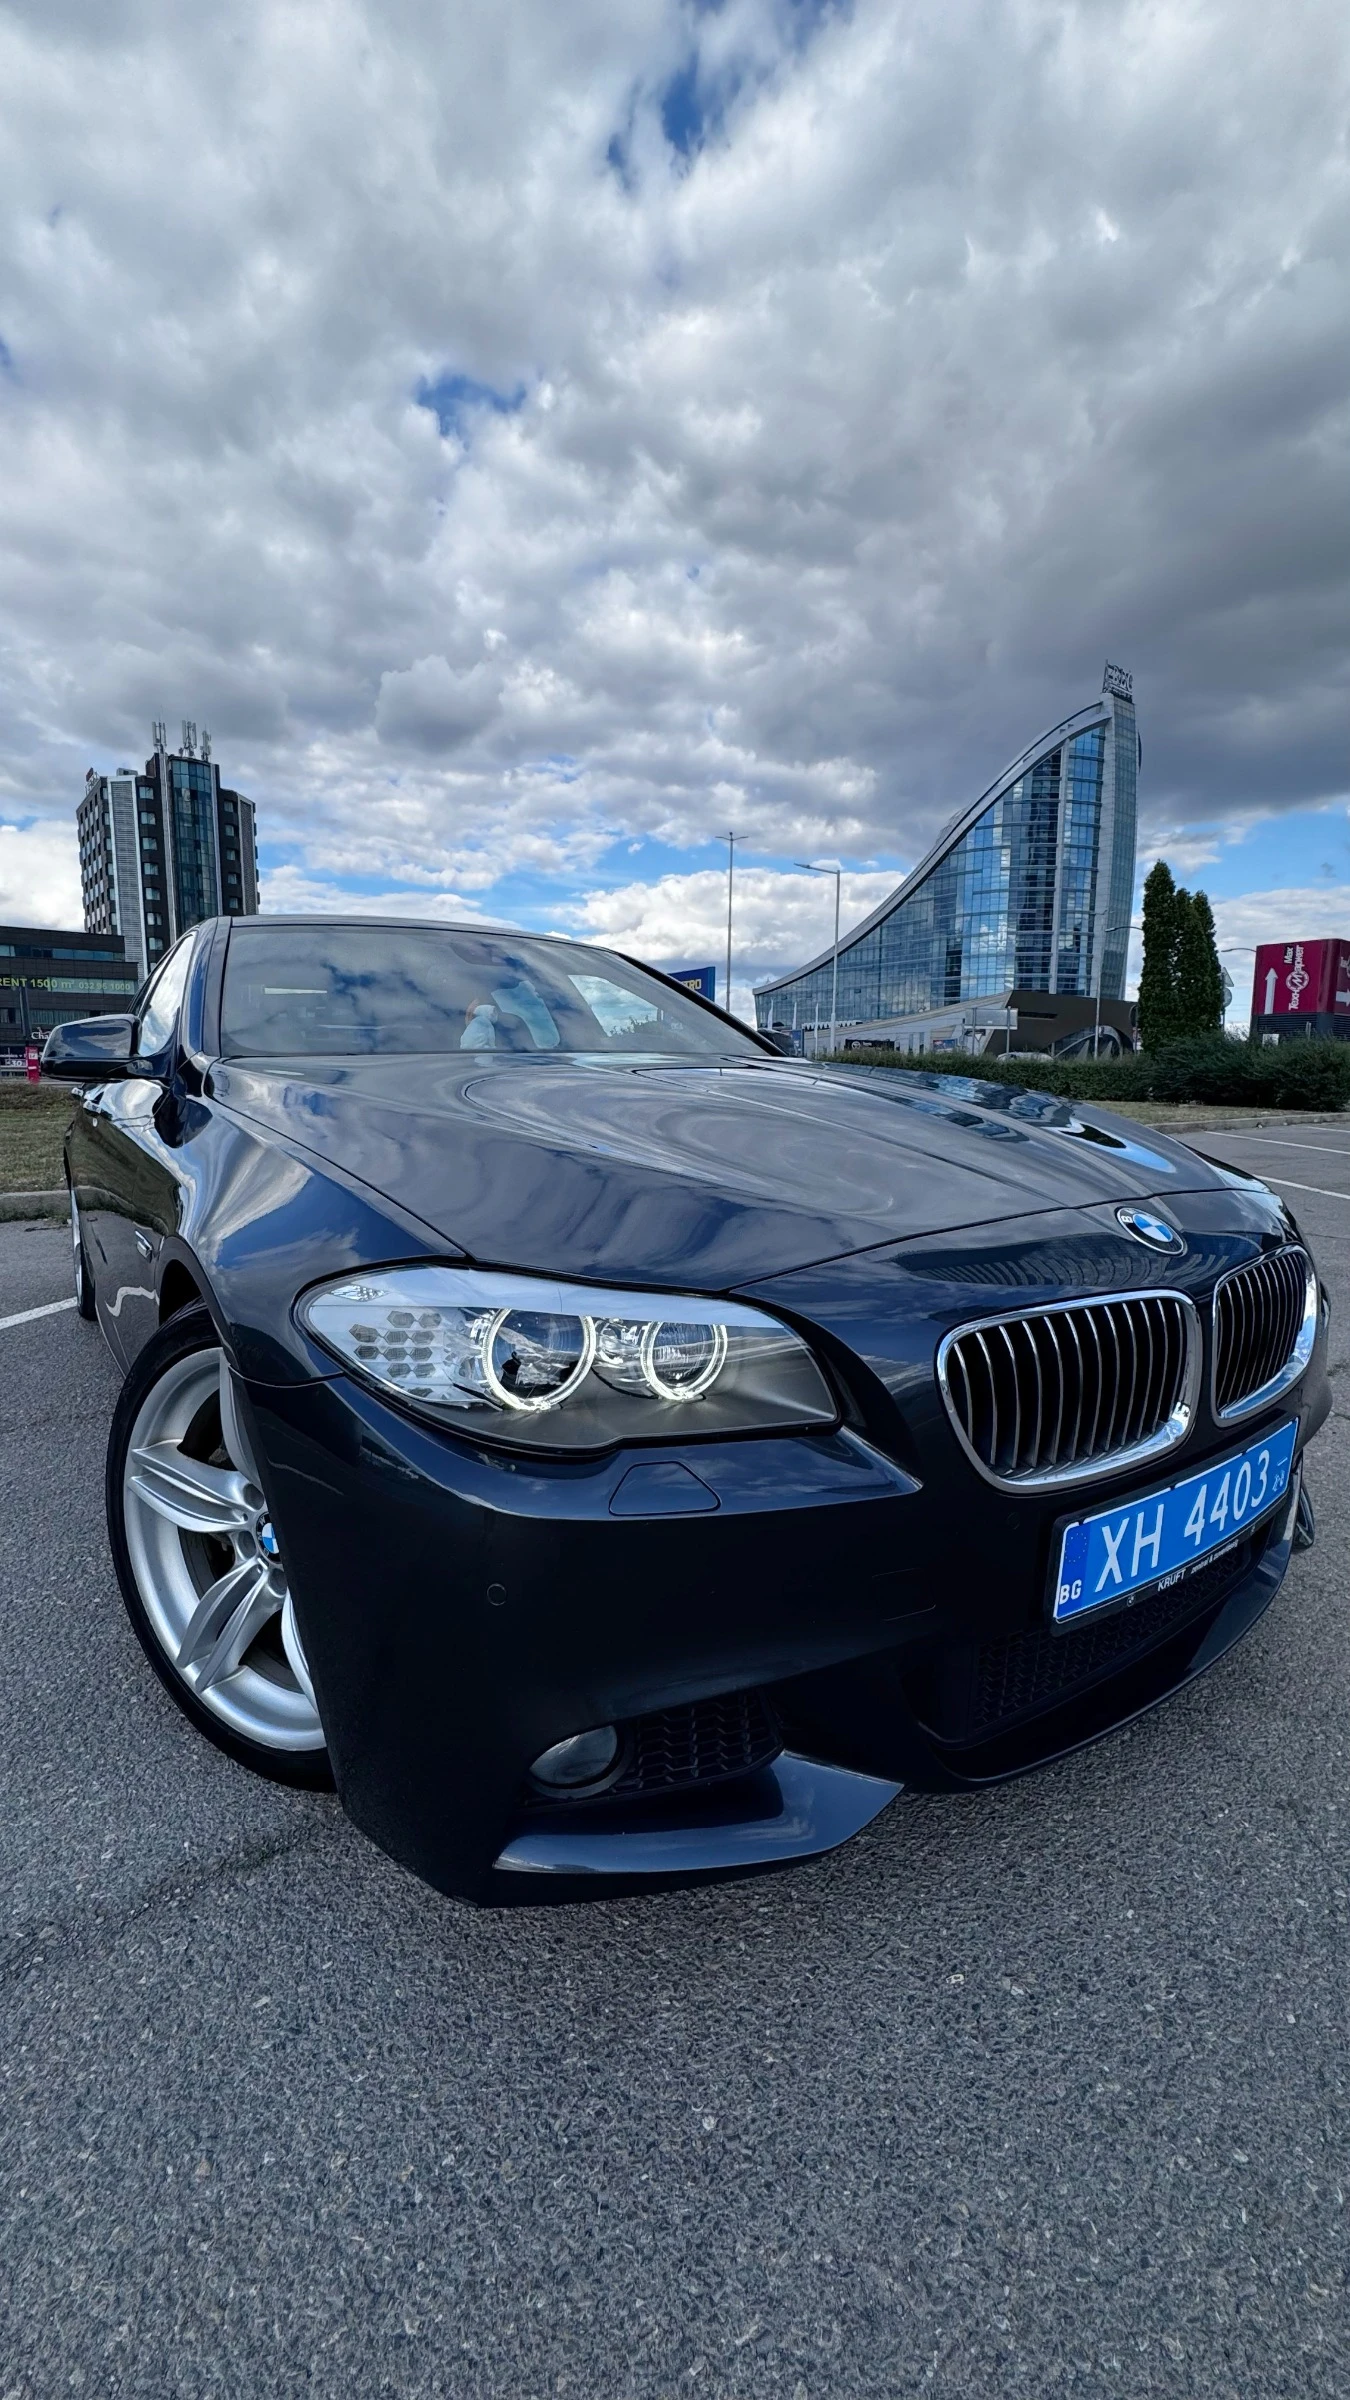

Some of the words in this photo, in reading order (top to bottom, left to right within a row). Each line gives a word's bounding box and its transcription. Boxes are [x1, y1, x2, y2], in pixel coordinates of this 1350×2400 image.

[30, 978, 58, 988] 1500
[1094, 1503, 1165, 1593] XH
[1184, 1449, 1270, 1547] 4403
[1058, 1579, 1082, 1605] BG
